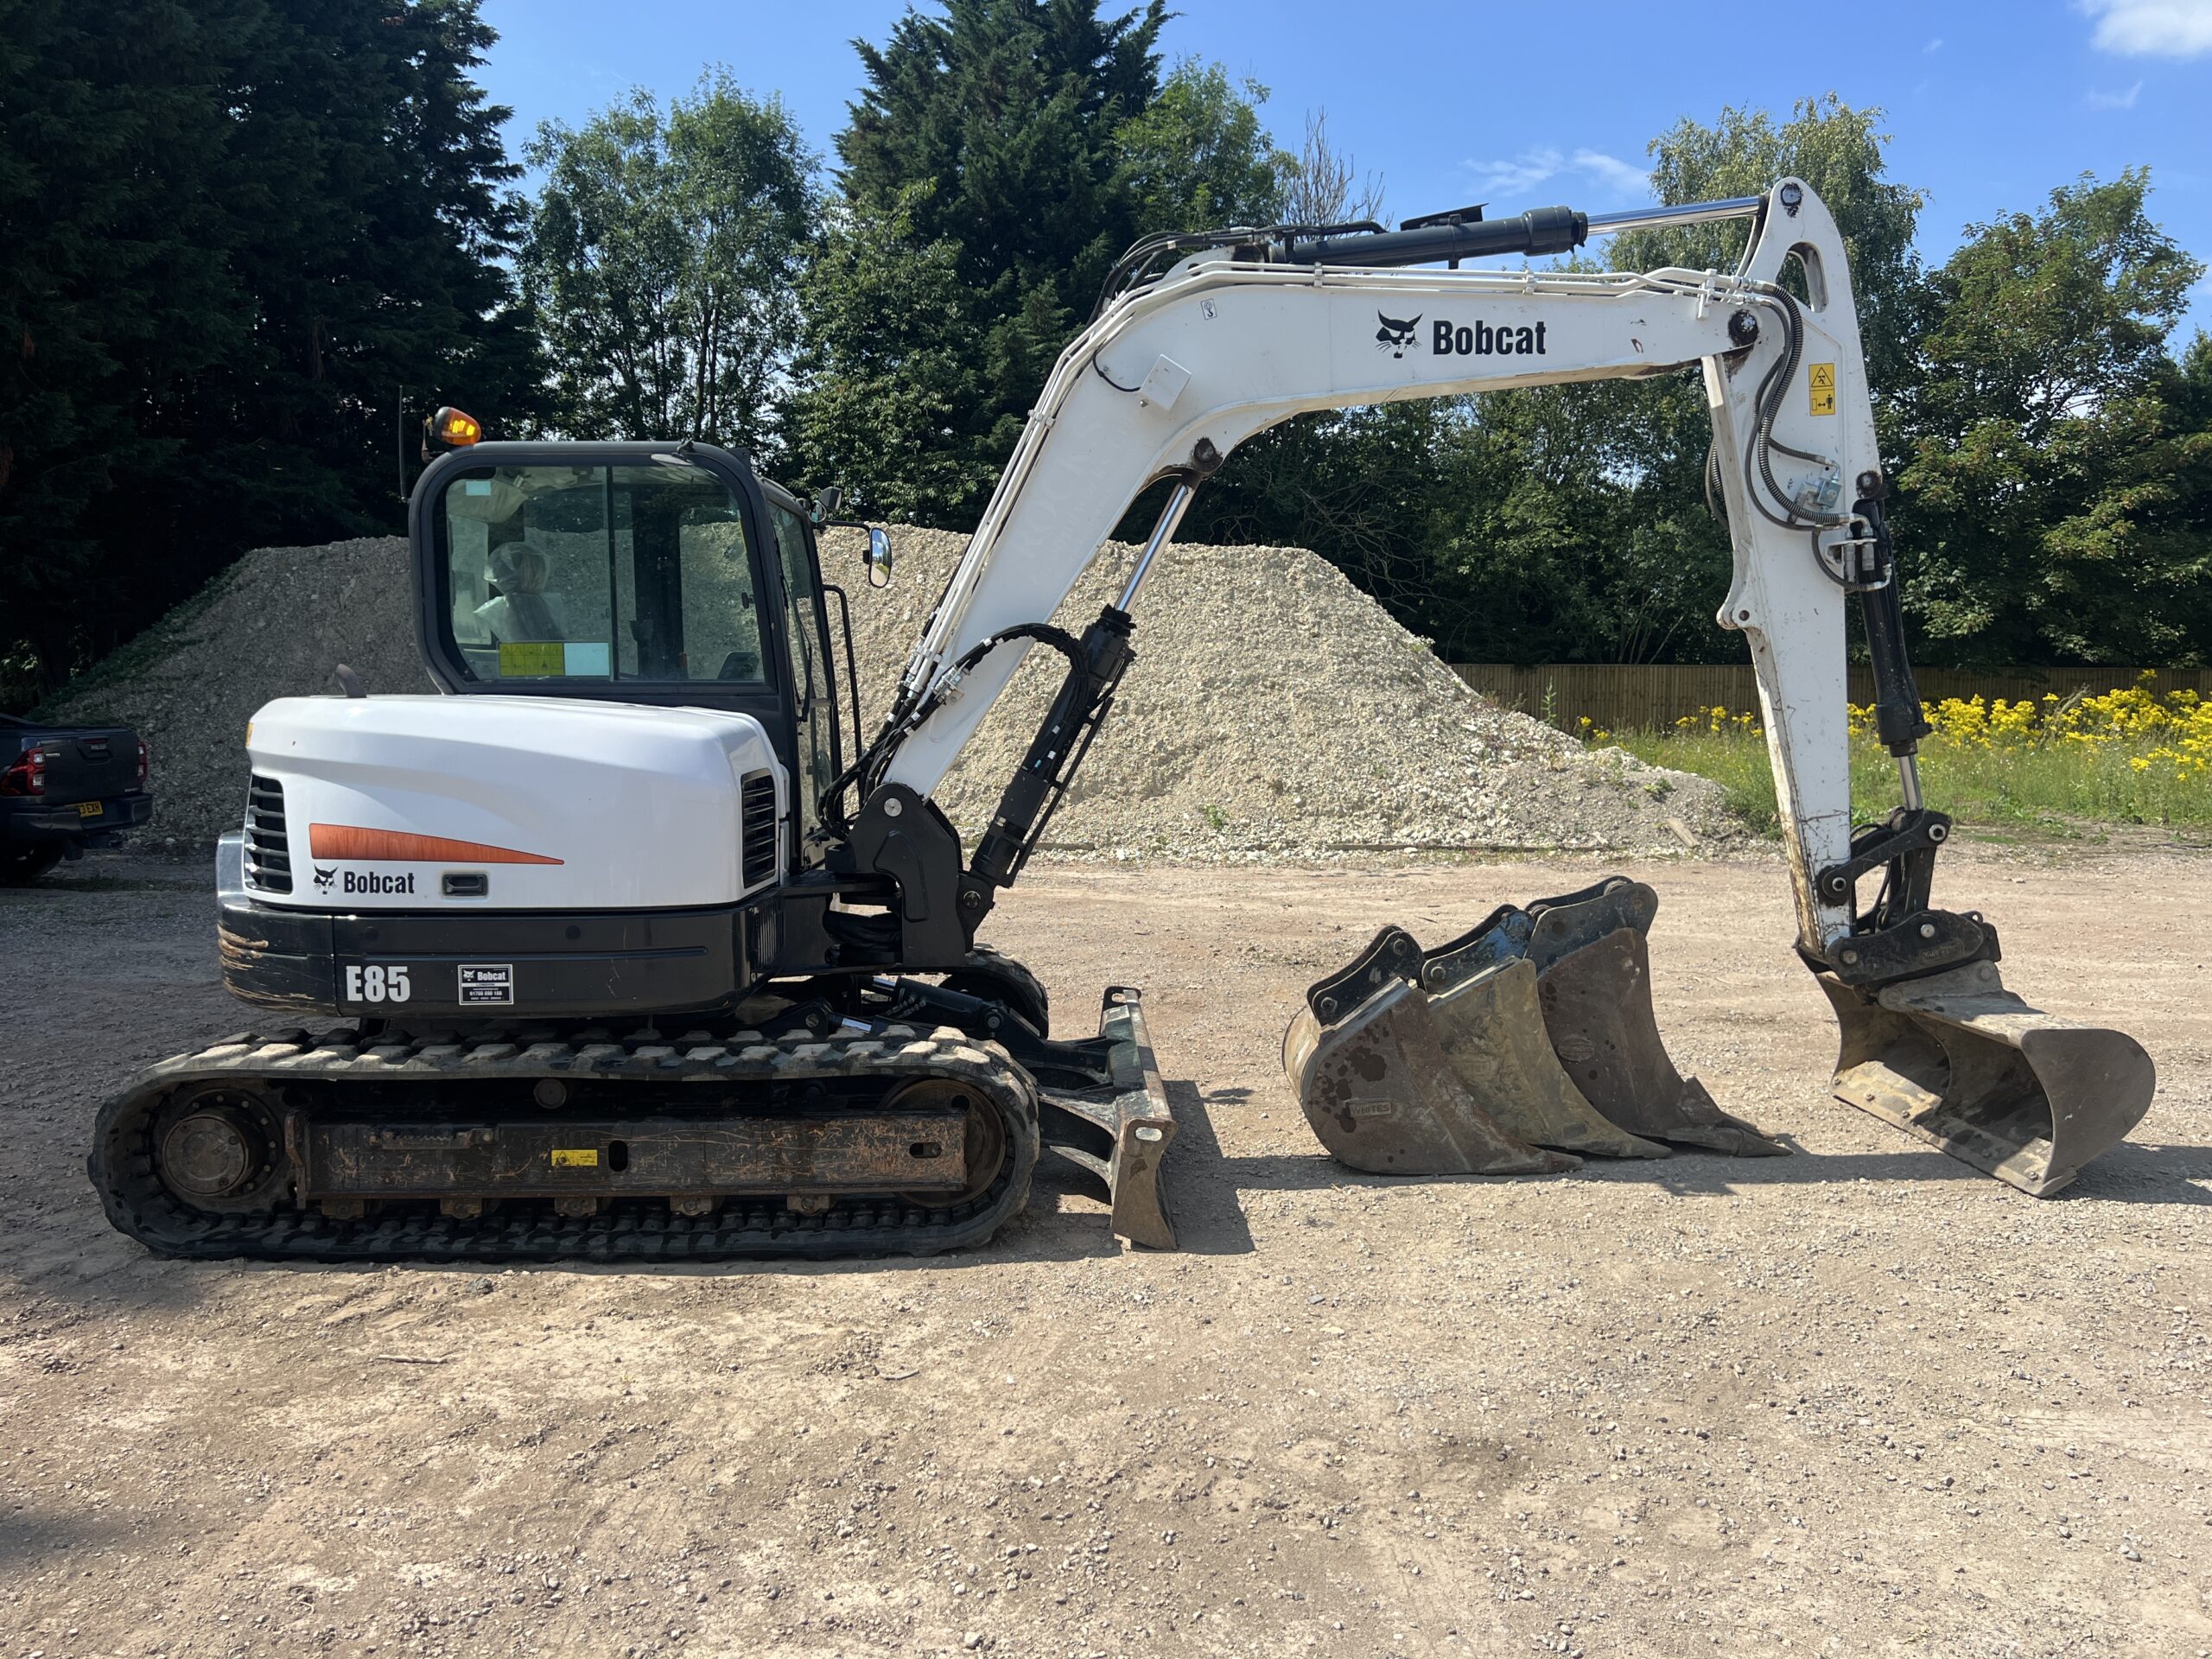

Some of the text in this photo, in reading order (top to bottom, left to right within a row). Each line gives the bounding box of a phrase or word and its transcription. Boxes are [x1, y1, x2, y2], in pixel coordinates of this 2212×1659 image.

[1433, 320, 1547, 355] Bobcat
[344, 871, 415, 893] Bobcat
[346, 965, 410, 1002] E85
[477, 971, 505, 981] Bobcat
[1351, 1104, 1389, 1114] WHITES
